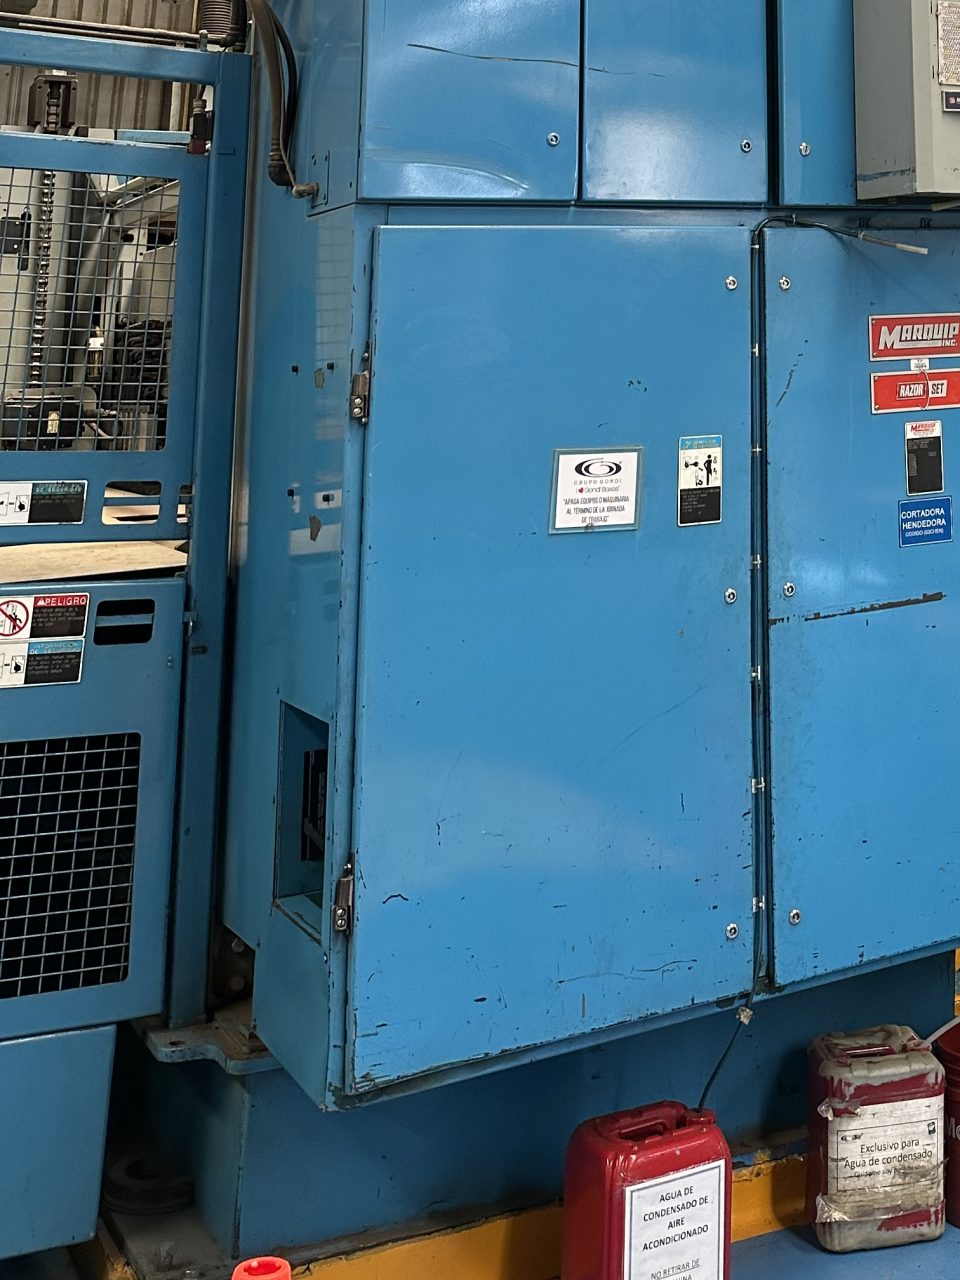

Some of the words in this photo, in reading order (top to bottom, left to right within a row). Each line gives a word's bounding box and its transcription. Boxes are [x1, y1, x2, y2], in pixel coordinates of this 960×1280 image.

[878, 322, 960, 350] MARQUIP
[942, 339, 958, 347] INC.
[900, 383, 924, 398] RAZOR
[931, 382, 944, 395] SET
[901, 508, 945, 519] CORTADORA
[902, 518, 946, 530] HENDEDORA
[44, 596, 87, 605] PELIGRO
[860, 1140, 899, 1154] Exclusivo
[901, 1138, 920, 1150] para
[844, 1159, 866, 1170] Agua
[868, 1156, 880, 1166] de
[882, 1148, 933, 1164] condensado
[660, 1189, 682, 1202] AGUA
[684, 1185, 693, 1196] DE
[643, 1199, 697, 1222] CONDENSADO
[699, 1196, 708, 1206] DE
[667, 1217, 685, 1229] AIRE
[643, 1224, 709, 1251] ACONDICIONADO
[651, 1271, 661, 1280] NO
[663, 1261, 690, 1276] RETIRAR
[692, 1258, 700, 1269] DE
